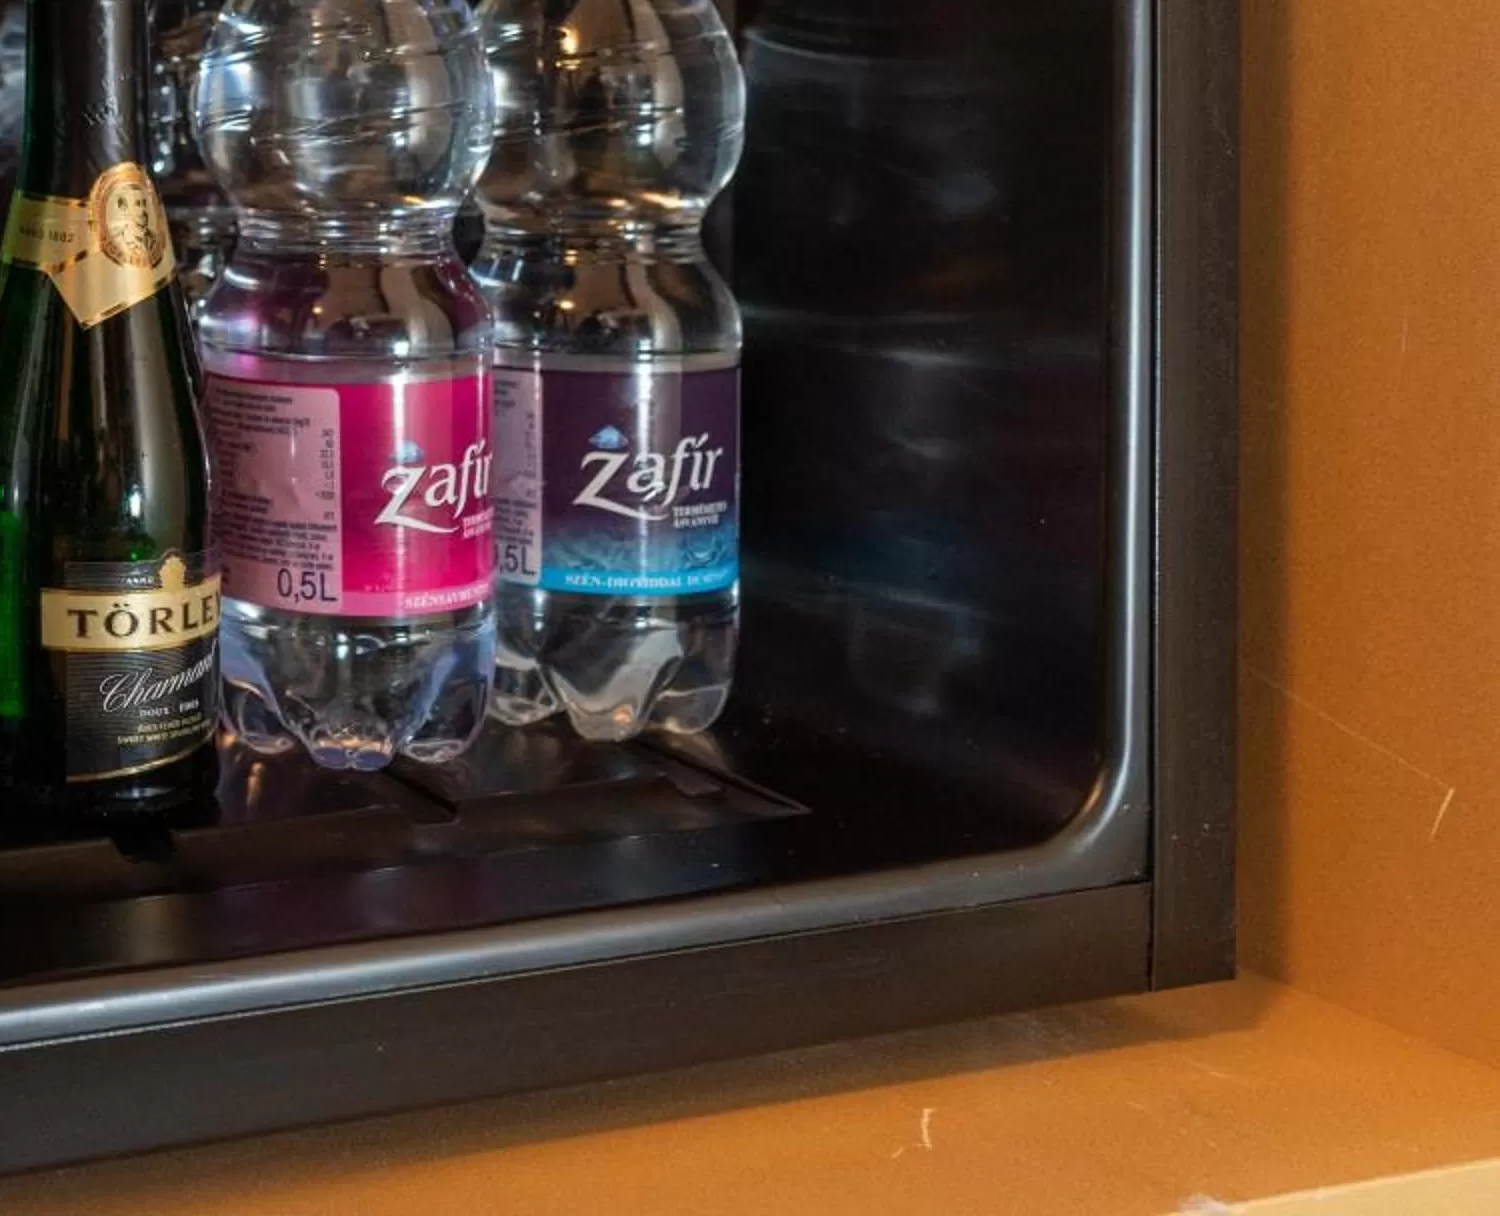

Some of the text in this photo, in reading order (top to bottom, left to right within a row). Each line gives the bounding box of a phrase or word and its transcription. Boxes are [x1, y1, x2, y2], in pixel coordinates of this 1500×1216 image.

[374, 437, 493, 534] Zafír
[572, 432, 724, 521] Zafír
[66, 590, 220, 640] TÖRLE
[277, 567, 338, 604] 0,5L
